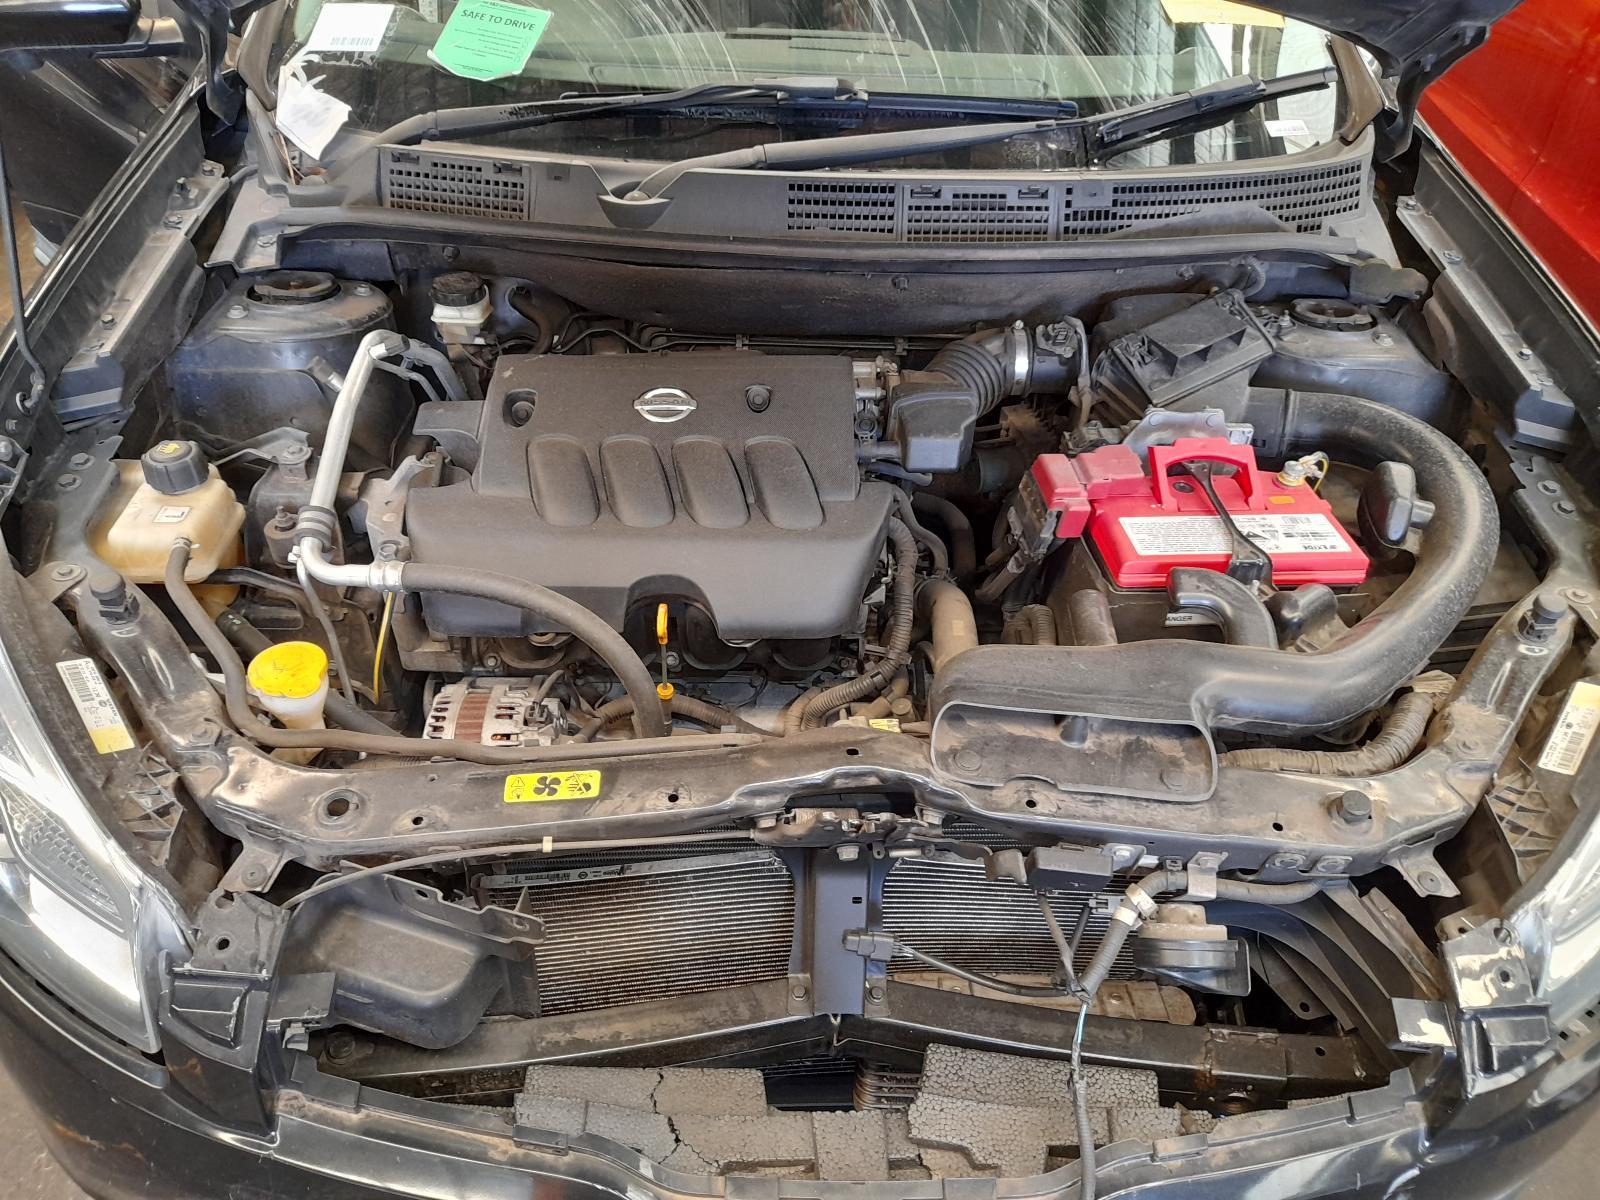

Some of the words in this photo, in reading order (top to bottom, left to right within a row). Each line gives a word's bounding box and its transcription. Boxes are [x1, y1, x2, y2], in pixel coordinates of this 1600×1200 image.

[461, 9, 486, 21] SAFE
[489, 15, 503, 24] TO
[504, 18, 536, 31] DRIVE
